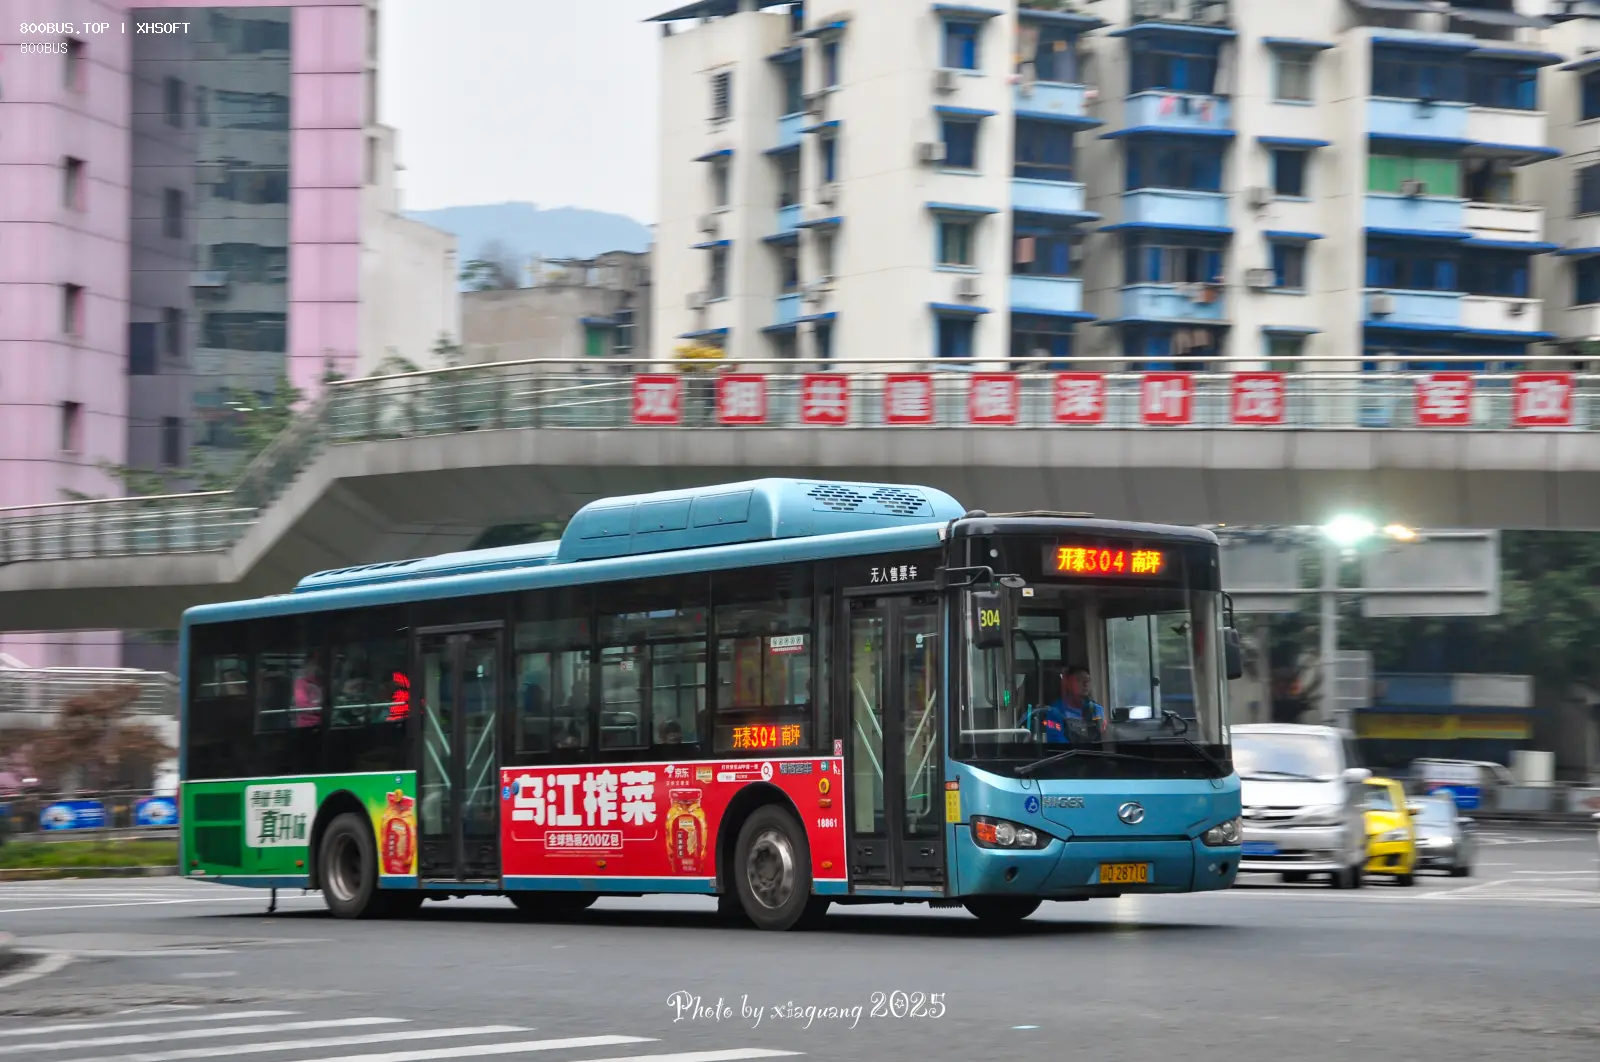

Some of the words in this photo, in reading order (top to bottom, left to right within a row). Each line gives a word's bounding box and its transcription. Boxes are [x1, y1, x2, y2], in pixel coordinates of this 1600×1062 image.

[870, 564, 918, 583] 无人售票车
[980, 609, 1001, 628] 304
[674, 767, 690, 779] 京东
[511, 769, 658, 828] 乌江榨菜
